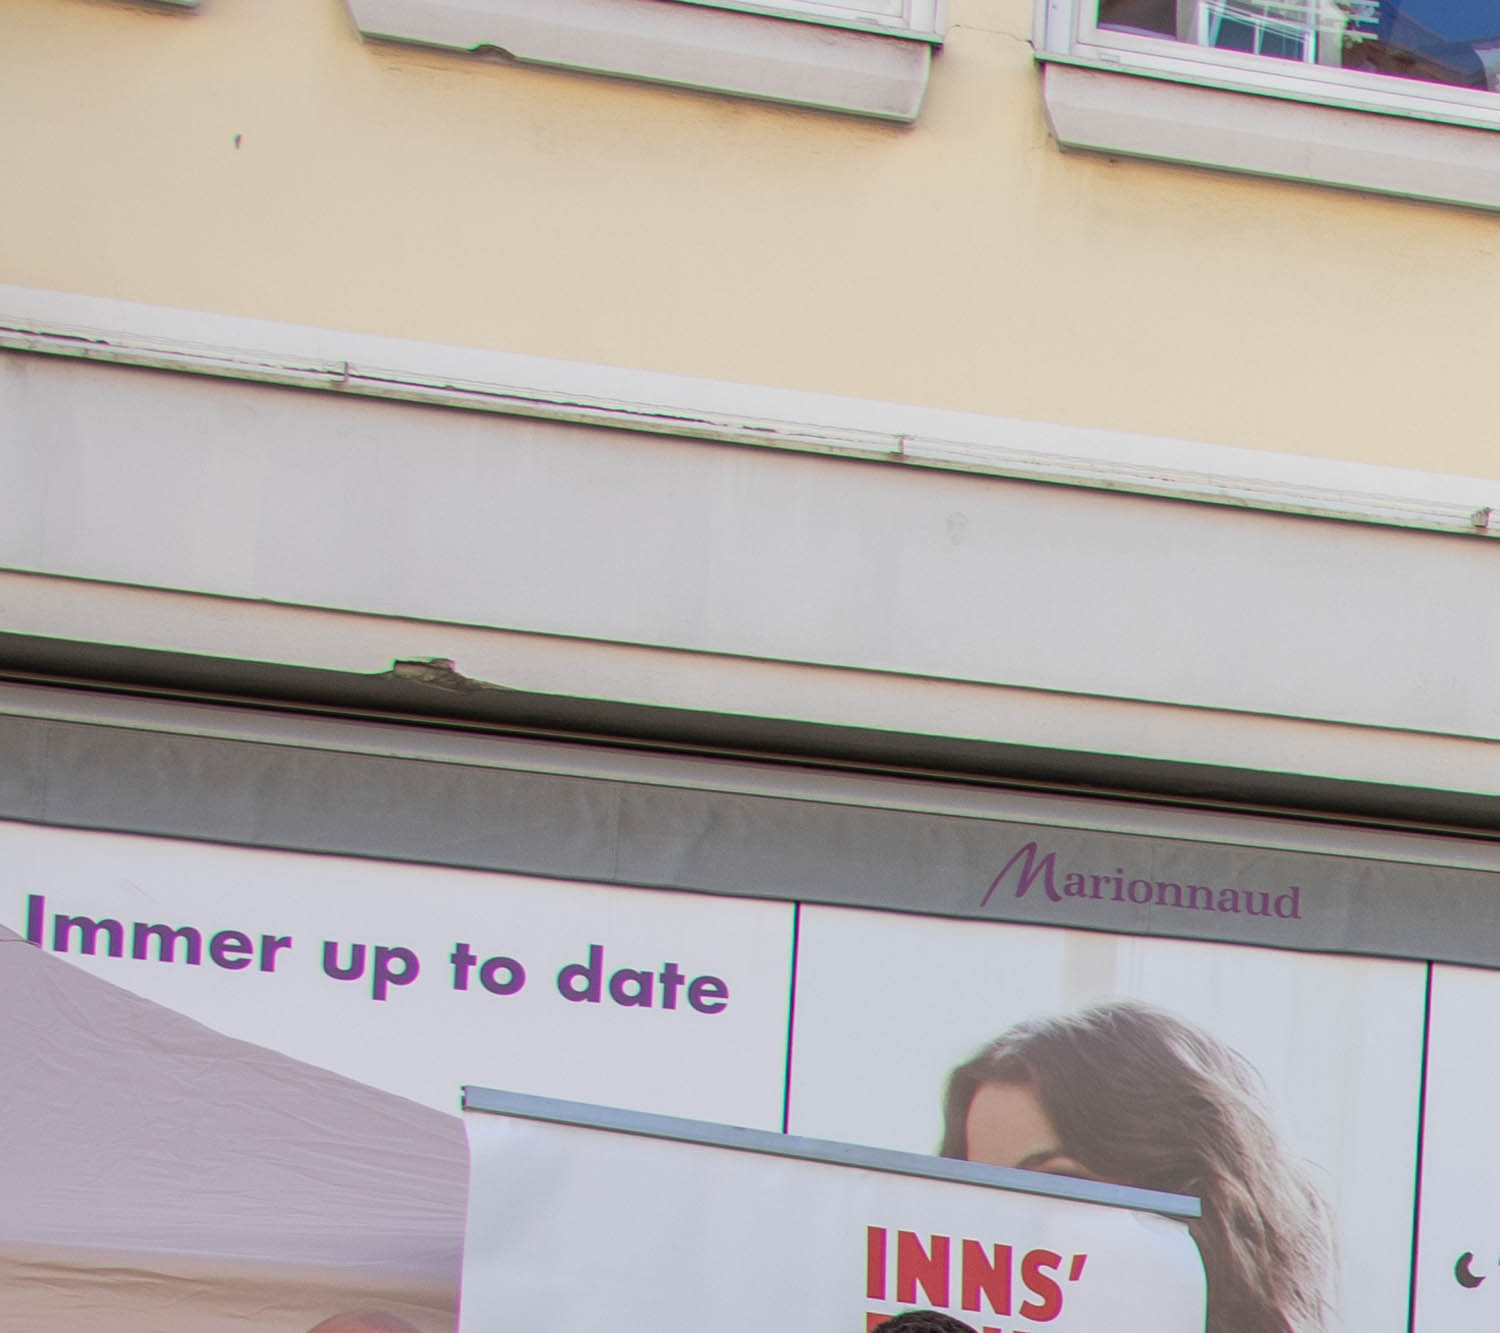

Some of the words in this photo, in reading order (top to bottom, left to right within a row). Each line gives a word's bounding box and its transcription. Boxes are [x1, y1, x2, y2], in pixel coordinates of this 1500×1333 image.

[980, 840, 1303, 921] Marionnaud
[26, 893, 292, 974] Immer
[322, 939, 421, 1002] up
[450, 942, 527, 996] to
[556, 944, 731, 1016] date
